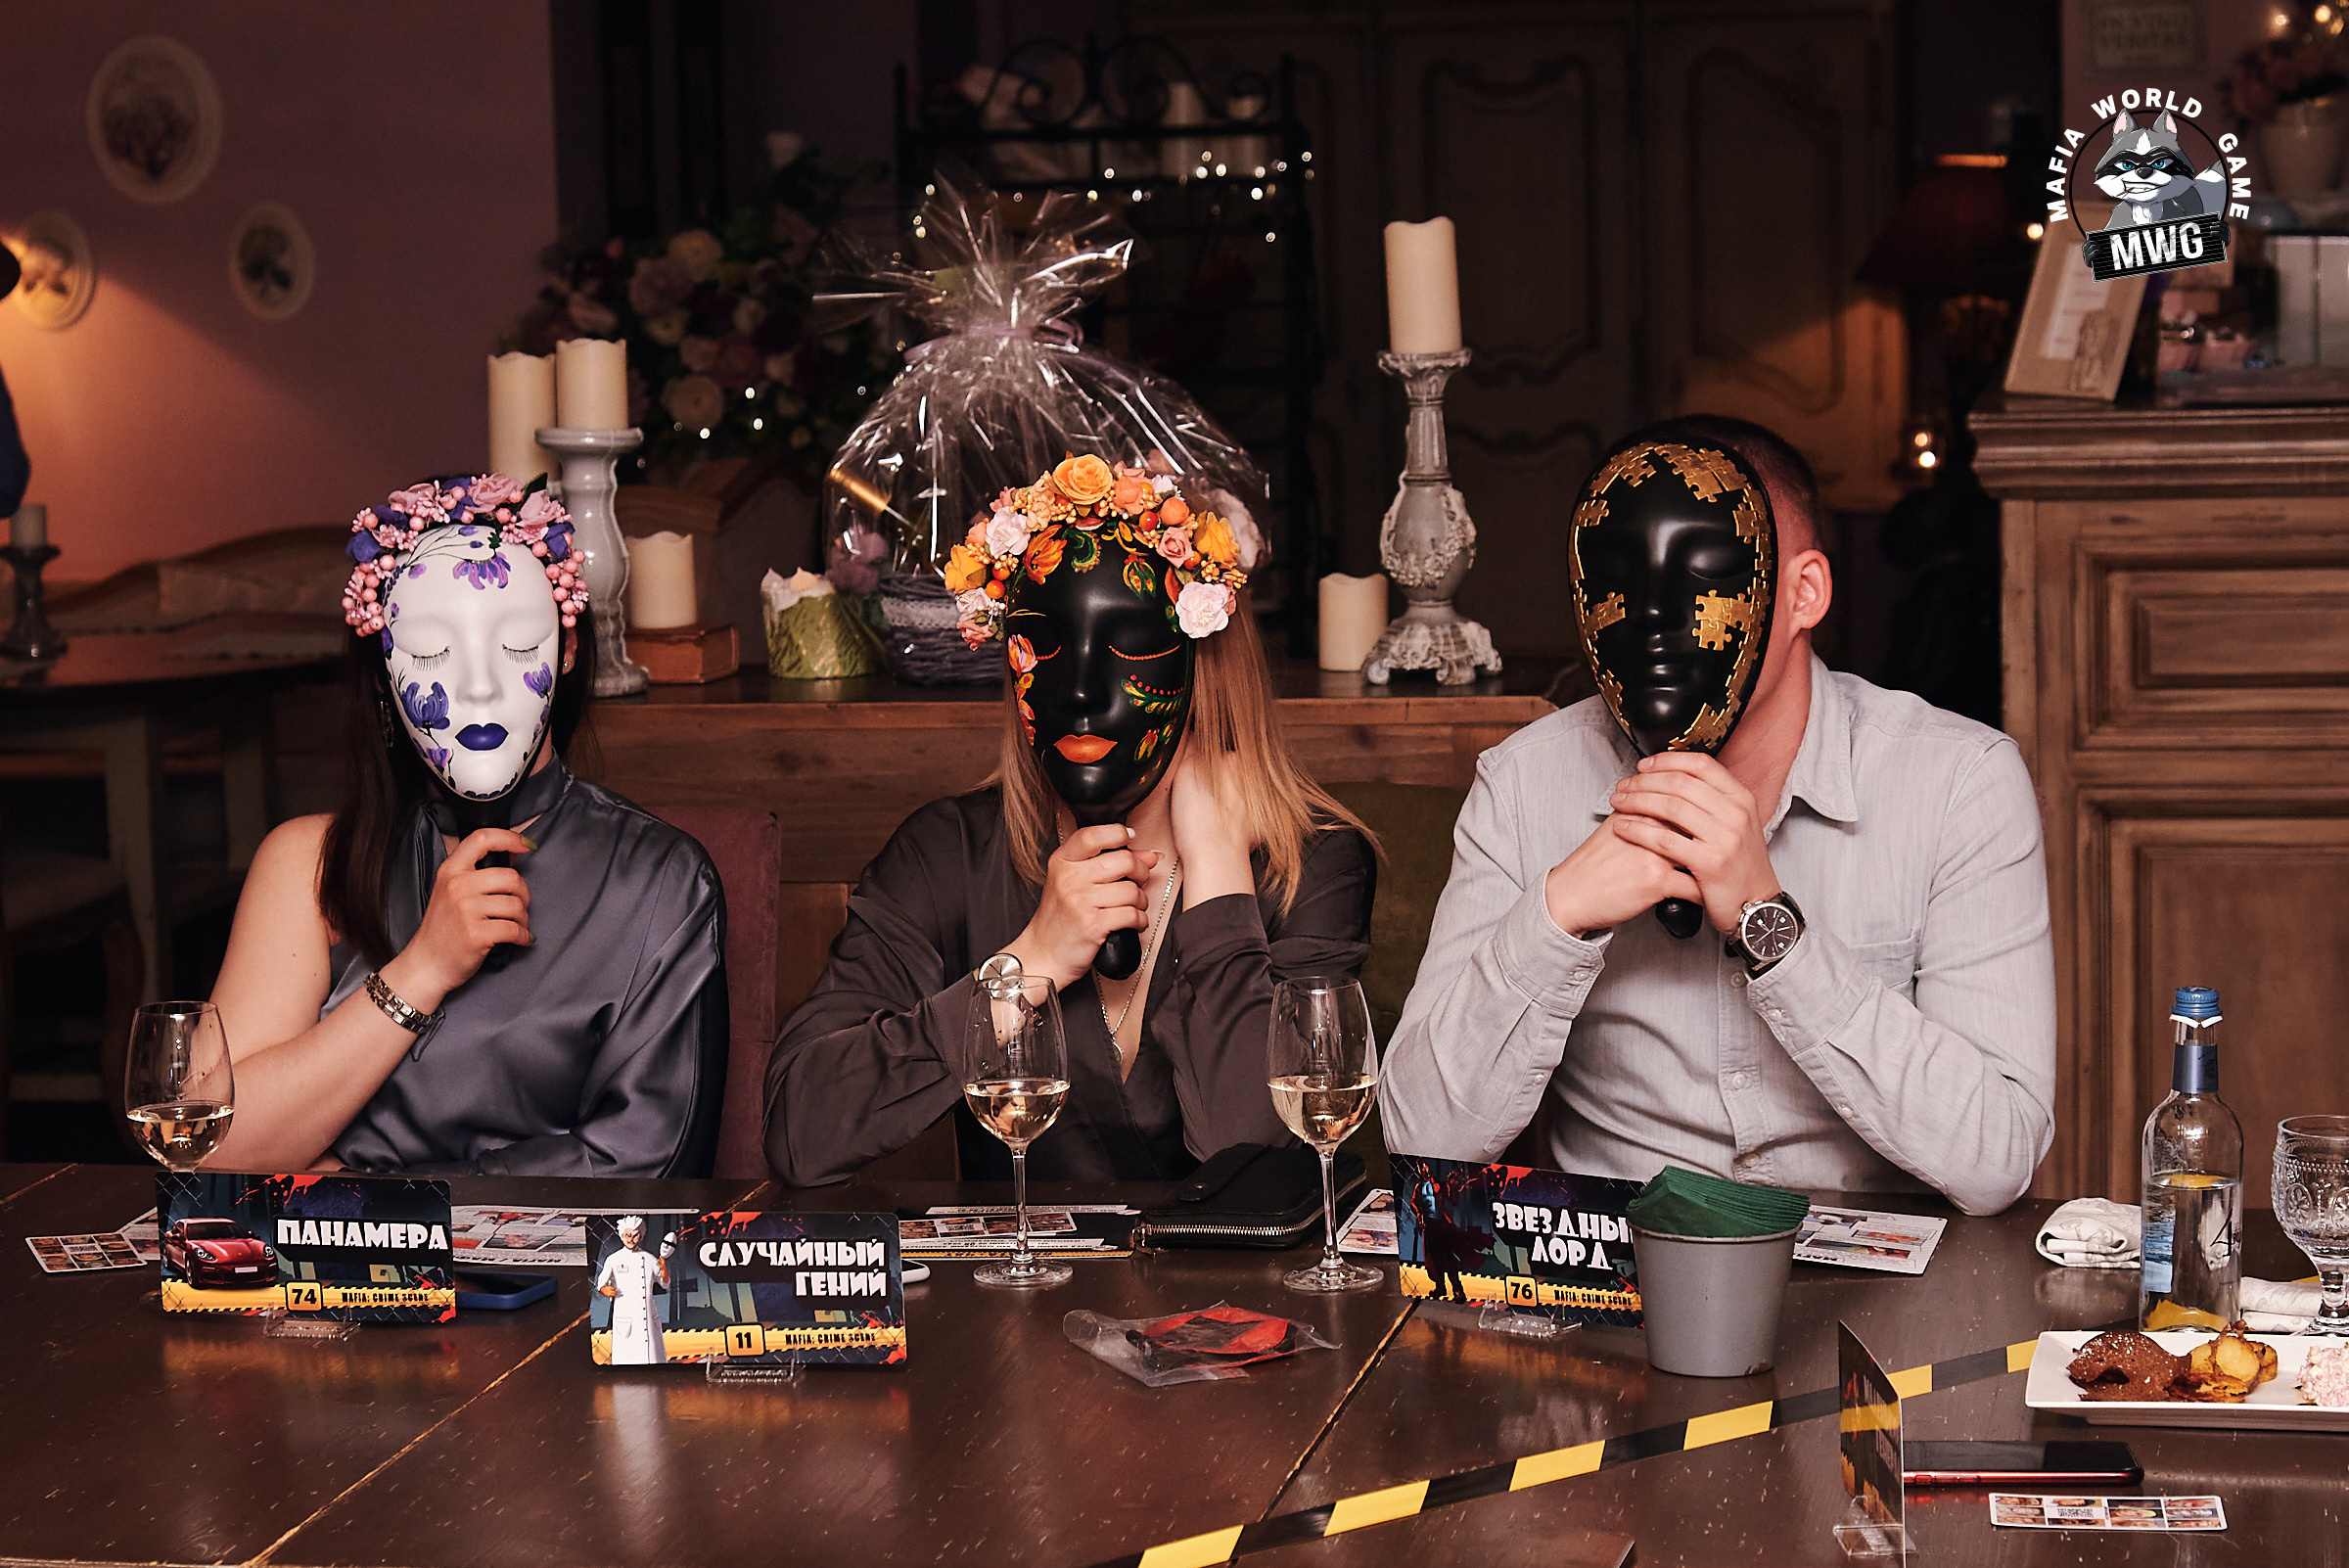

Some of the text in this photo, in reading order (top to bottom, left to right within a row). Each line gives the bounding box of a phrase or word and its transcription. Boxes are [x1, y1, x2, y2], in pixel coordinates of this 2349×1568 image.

[1492, 1202, 1633, 1244] ЗВЕЗДНЫ
[277, 1219, 448, 1250] ПАНАМЕРА
[699, 1238, 885, 1268] СЛУЧАЙНЫЙ
[1531, 1236, 1613, 1270] ЛОРД
[795, 1268, 887, 1297] ГЕНИЙ
[1510, 1282, 1533, 1300] 76
[292, 1288, 317, 1305] 74
[342, 1292, 429, 1303] MAFIA: CRIME SCENE
[1554, 1289, 1632, 1306] MAFIA: CRIME SCENE
[735, 1332, 753, 1349] 11
[785, 1332, 876, 1345] MAFIA: CRIME SCENE
